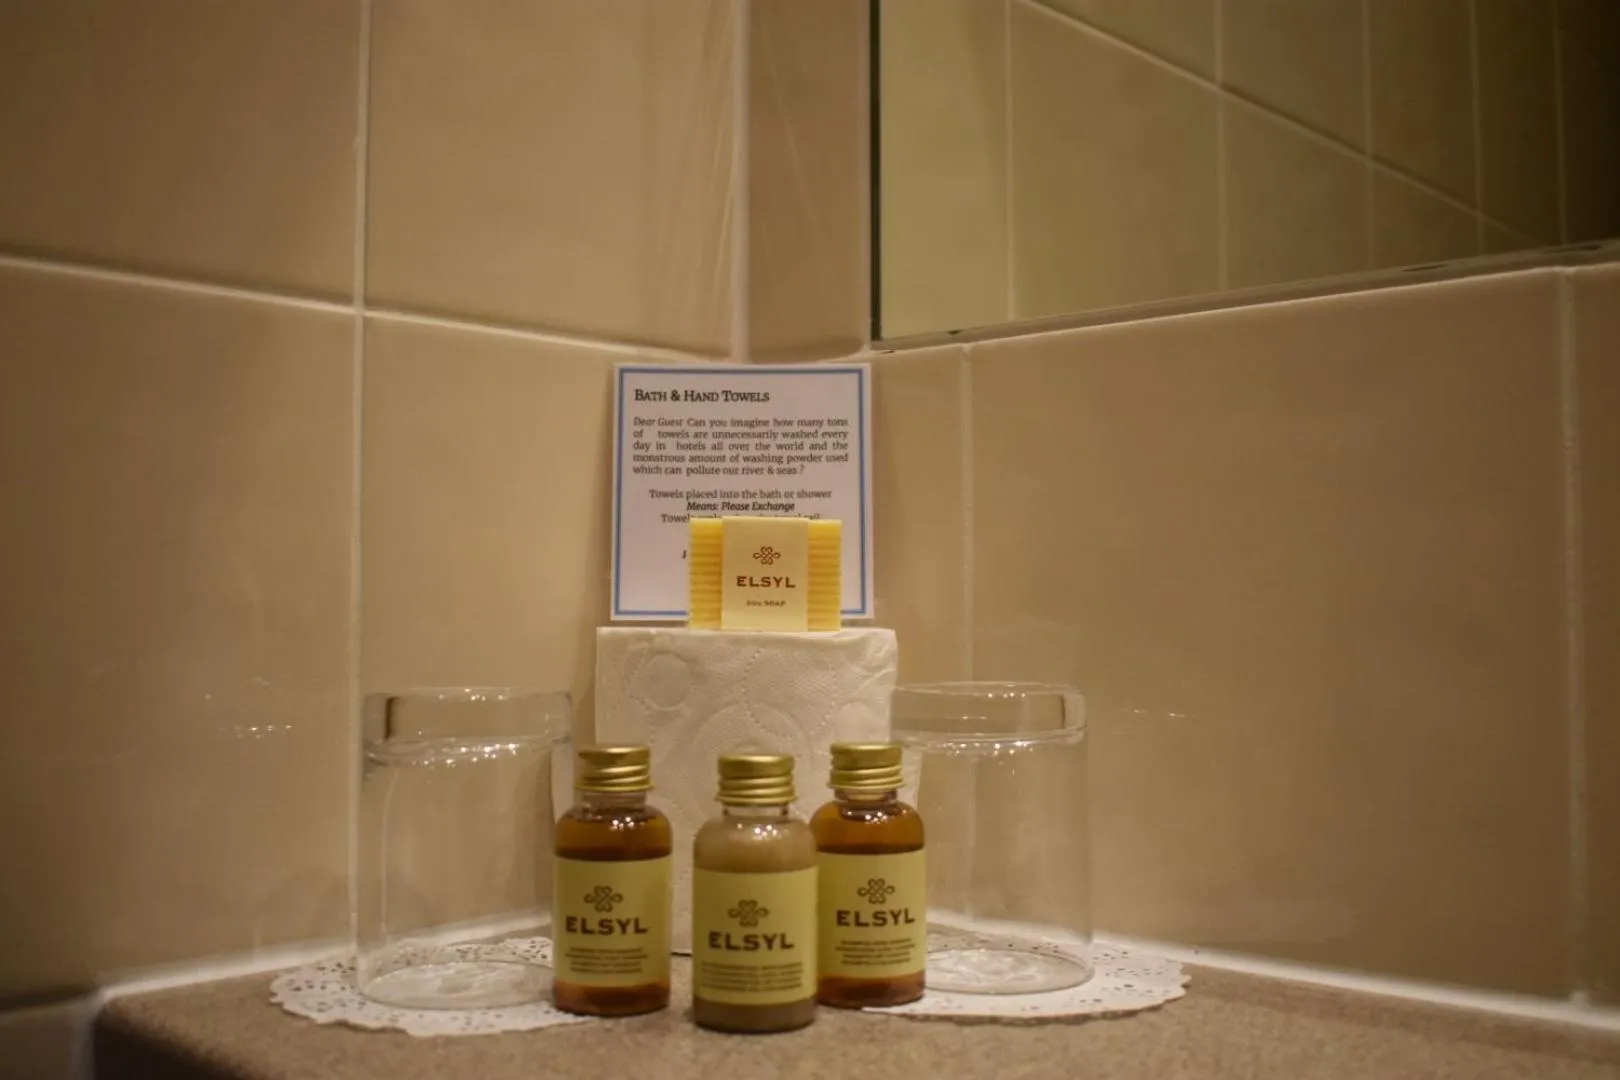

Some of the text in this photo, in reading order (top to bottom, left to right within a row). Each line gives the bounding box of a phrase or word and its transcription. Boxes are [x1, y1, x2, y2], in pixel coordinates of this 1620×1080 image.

[634, 389, 770, 402] BATH & HAND TOWELS
[633, 417, 848, 429] Dear Guest Can you imagine how many tons
[633, 430, 643, 439] of
[658, 430, 690, 439] towels
[712, 430, 779, 440] unnecessarily
[782, 430, 818, 439] washed
[822, 431, 848, 440] every
[633, 441, 649, 452] day
[656, 442, 666, 450] in
[676, 441, 706, 451] hotels
[711, 441, 723, 450] all
[755, 442, 772, 451] the
[776, 441, 804, 450] world
[810, 441, 827, 450] and
[832, 441, 848, 450] the
[633, 453, 848, 465] monstrous amount of washing powder used
[633, 465, 662, 474] which
[665, 466, 682, 475] can
[686, 465, 720, 477] pollute
[742, 466, 764, 475] river
[767, 466, 774, 475] &
[649, 490, 683, 499] Towels
[686, 490, 718, 501] placed
[720, 490, 739, 498] into
[742, 490, 758, 498] the
[760, 490, 781, 498] bath
[797, 490, 832, 498] shower
[686, 502, 795, 513] Means: Please Exchange
[661, 514, 692, 522] Towel
[737, 576, 796, 588] ELSYL
[836, 908, 915, 927] ELSYL
[565, 916, 648, 935] ELSYL
[708, 931, 794, 951] ELSYL
